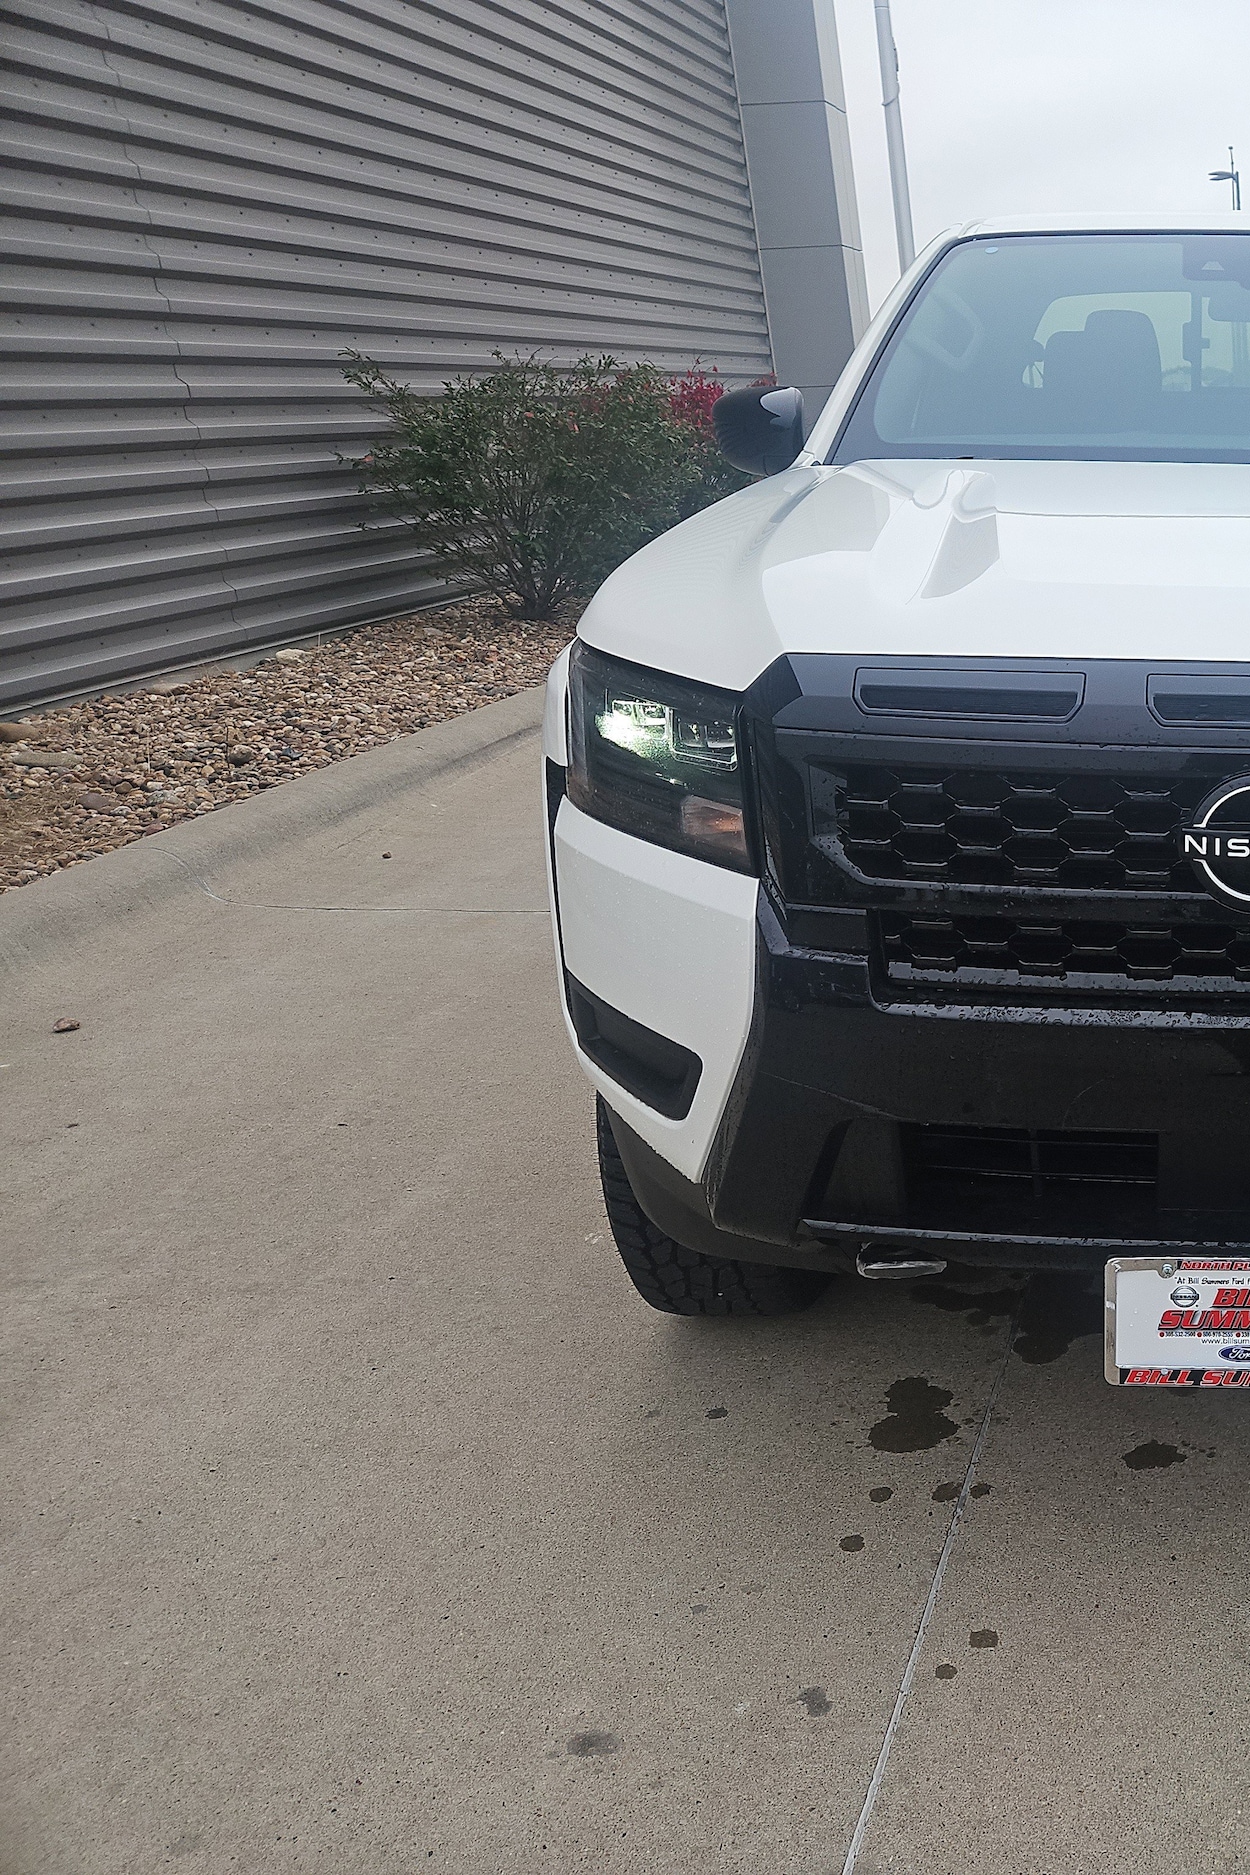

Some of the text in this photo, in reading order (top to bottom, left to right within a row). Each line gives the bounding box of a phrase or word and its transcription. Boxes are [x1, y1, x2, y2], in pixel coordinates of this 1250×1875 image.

[1181, 1260, 1231, 1271] NORTH
[1187, 1276, 1200, 1285] Bill
[1201, 1277, 1230, 1285] Summers
[1231, 1277, 1245, 1286] Ford
[1126, 1368, 1195, 1386] BILL
